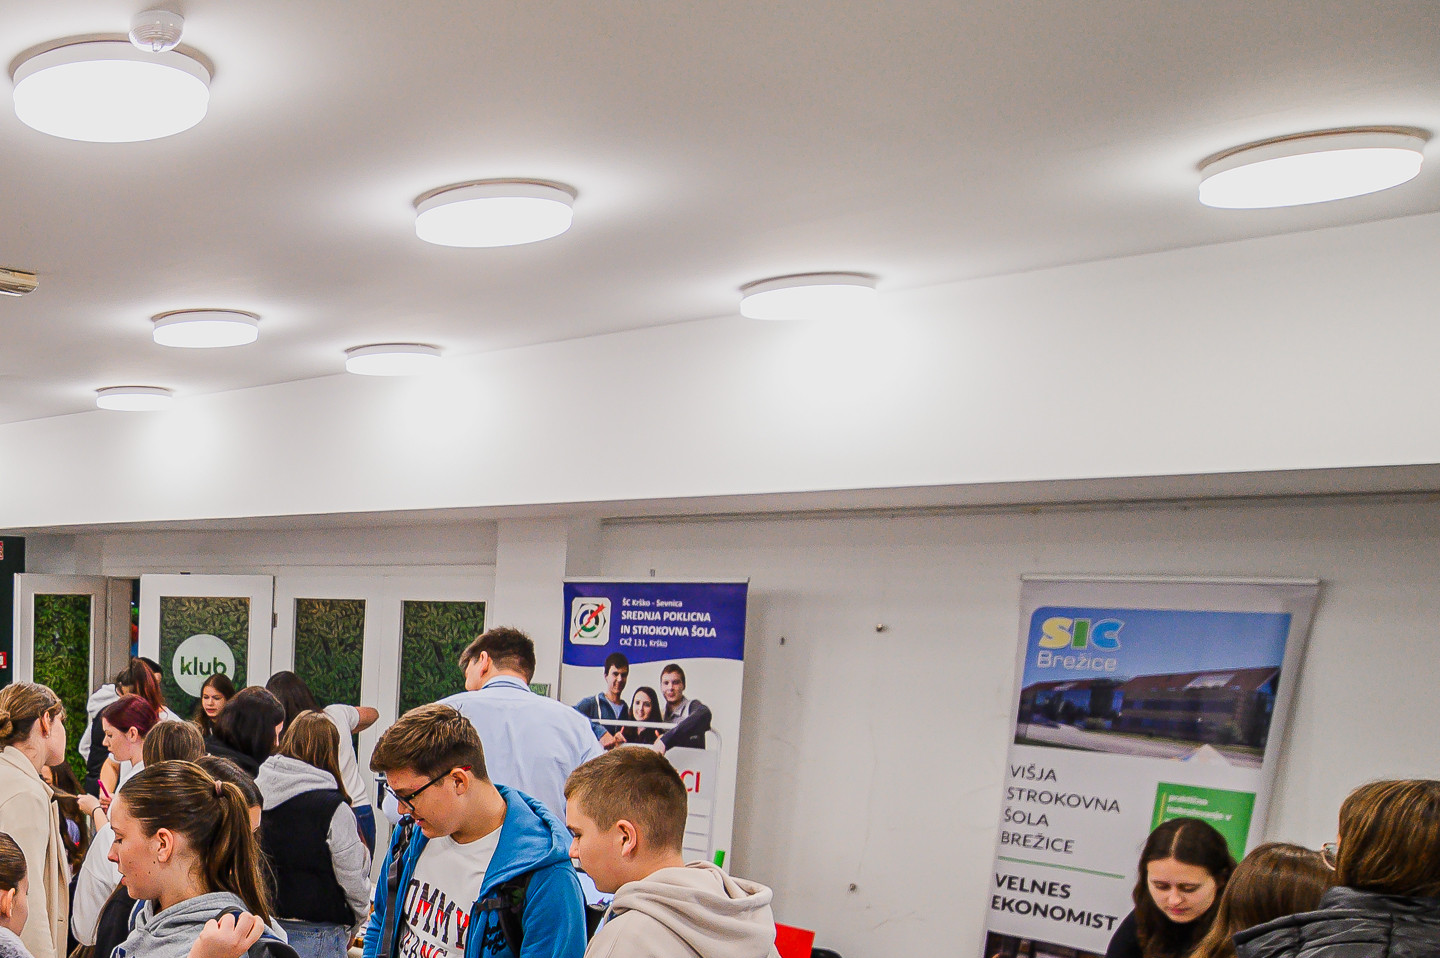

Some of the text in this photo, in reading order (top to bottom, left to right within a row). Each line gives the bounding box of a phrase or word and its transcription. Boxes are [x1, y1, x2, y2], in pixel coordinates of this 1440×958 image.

[656, 599, 682, 607] Sevnica
[621, 610, 711, 622] SREDNJA POKLICNA
[620, 625, 716, 637] IN STROKOVNA ŠOLA
[1039, 616, 1125, 651] SIC
[180, 656, 227, 675] klub
[1037, 650, 1117, 672] Brežice
[1010, 763, 1057, 782] VIŠJA
[1007, 786, 1120, 813] STROKOVNA
[1004, 806, 1049, 827] ŠOLA
[1001, 830, 1075, 854] BREŽICE
[996, 872, 1071, 899] VELNES
[991, 895, 1118, 931] EKONOMIST
